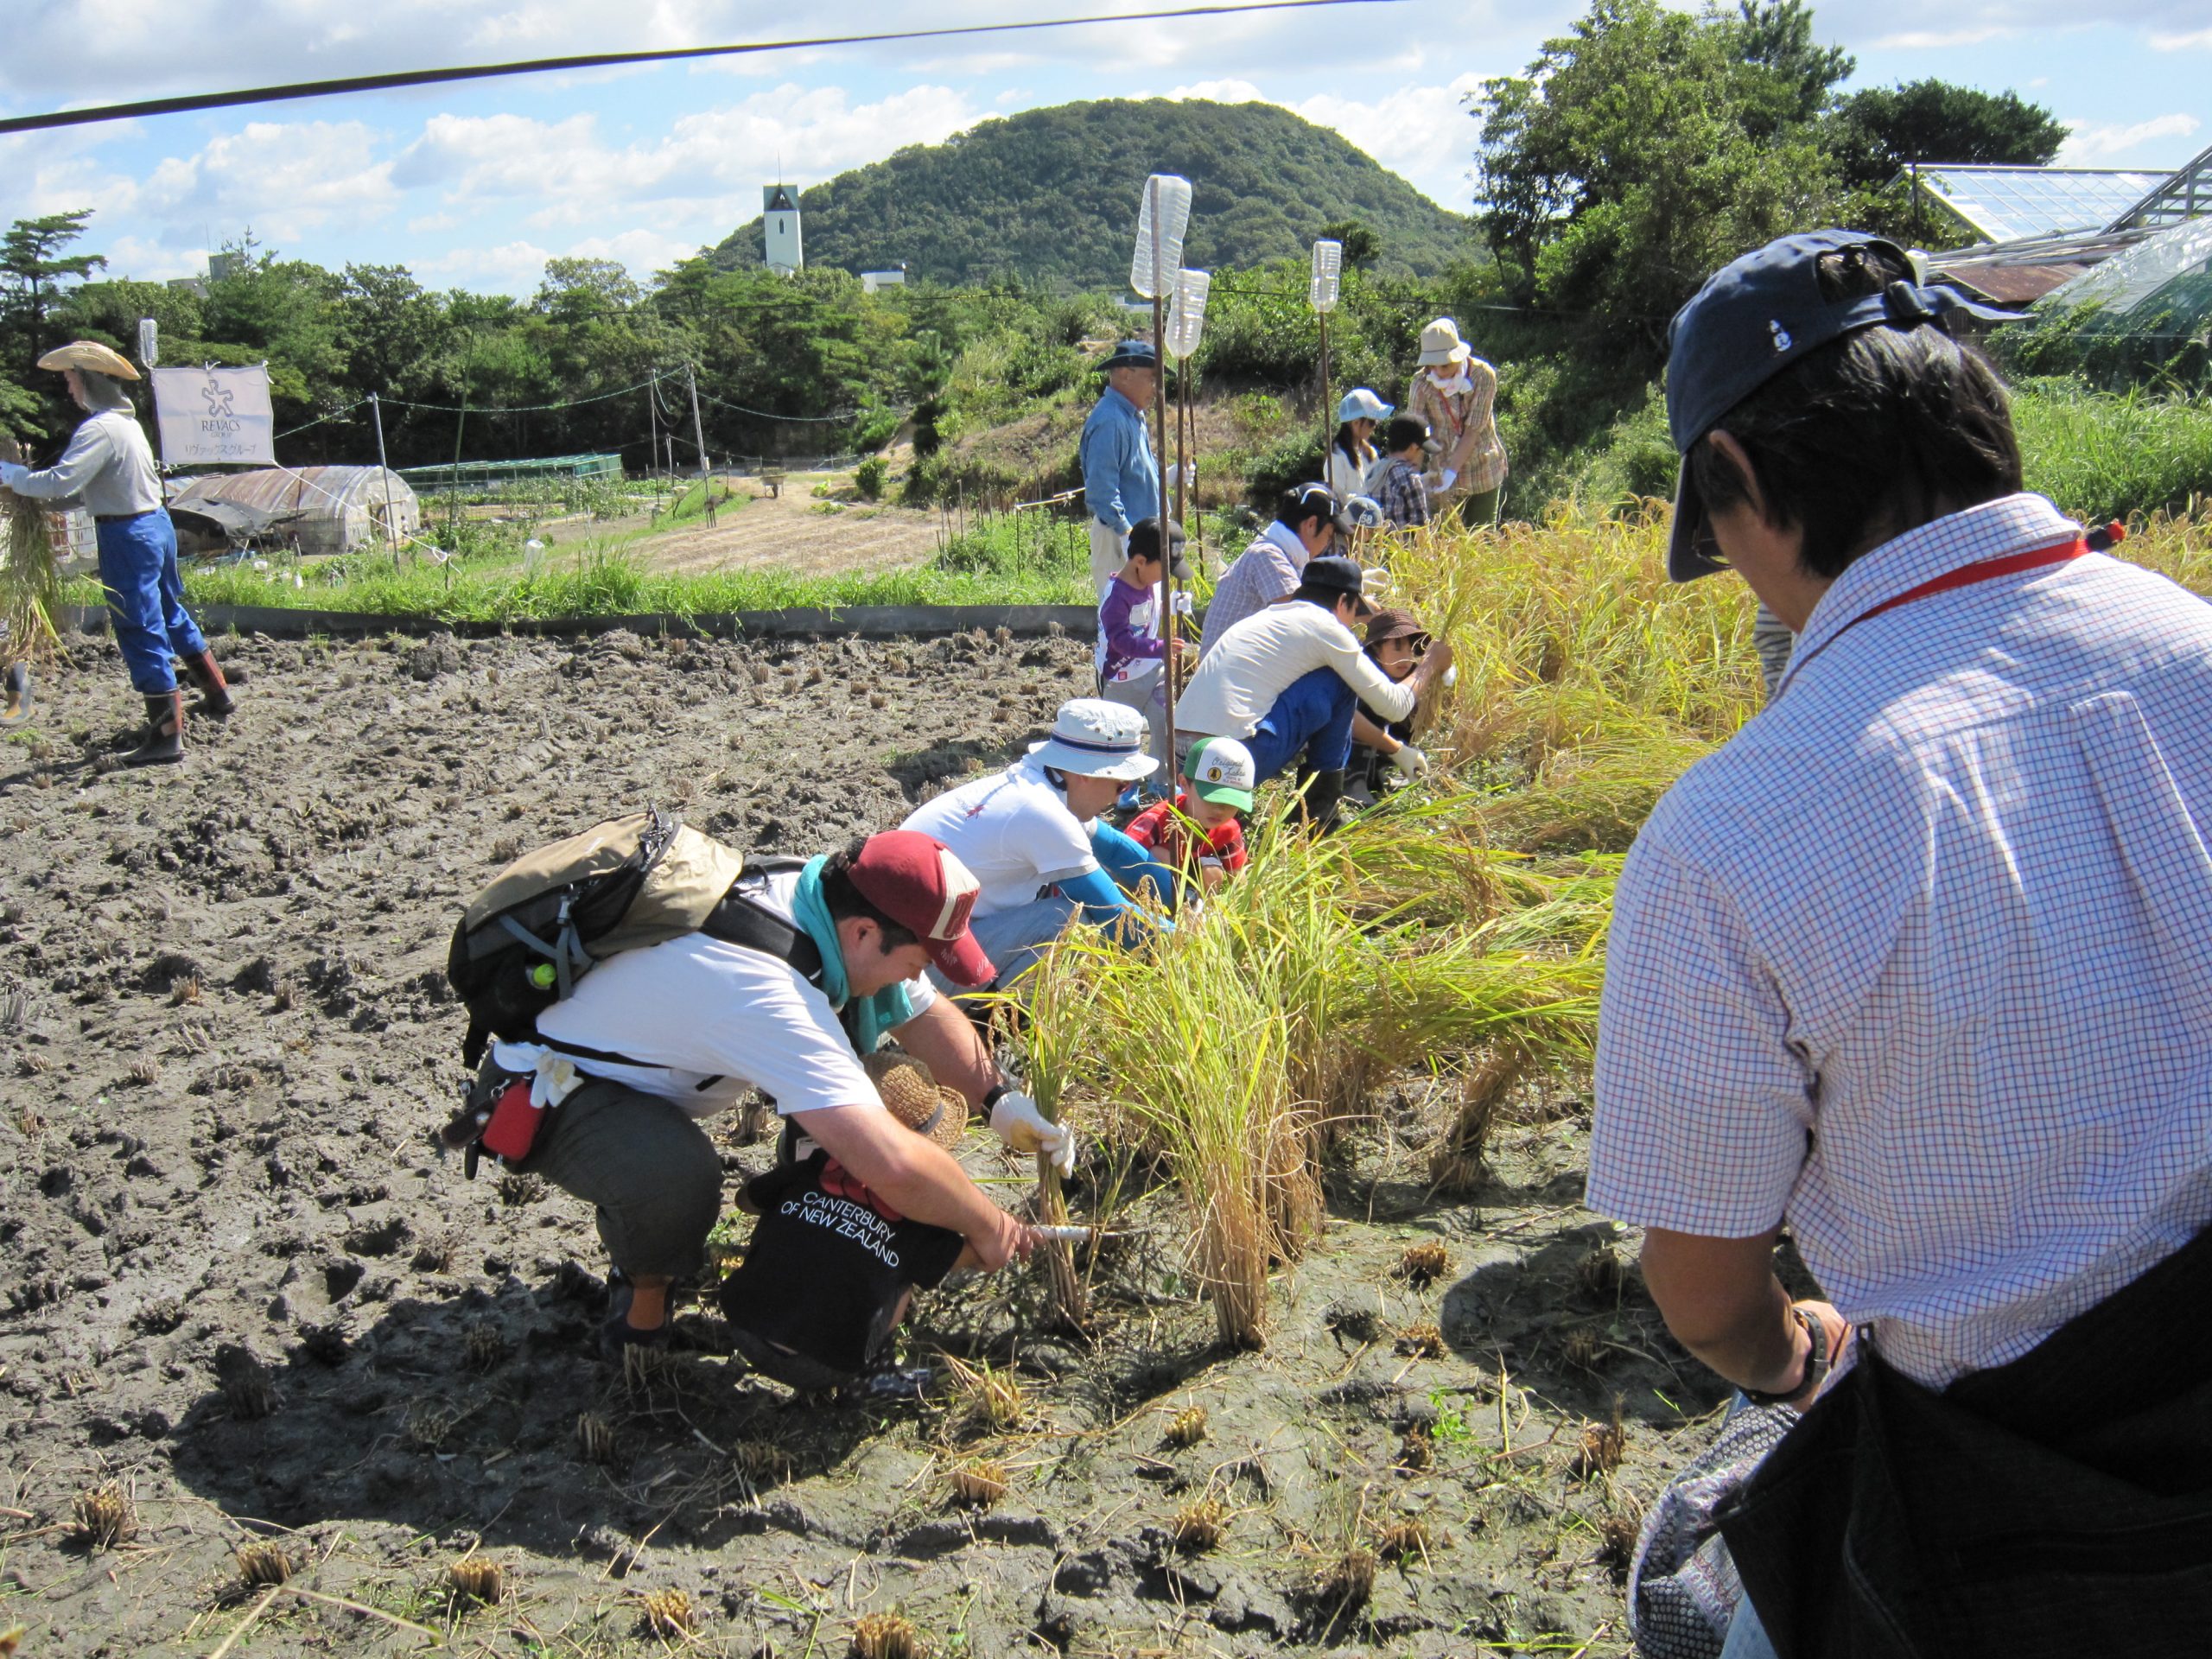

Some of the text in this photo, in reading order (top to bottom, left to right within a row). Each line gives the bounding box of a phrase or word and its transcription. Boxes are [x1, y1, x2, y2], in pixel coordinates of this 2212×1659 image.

[201, 420, 241, 431] REVACS
[781, 1201, 899, 1268] OF NEW ZEALAND
[803, 1192, 896, 1242] CANTERBURY
